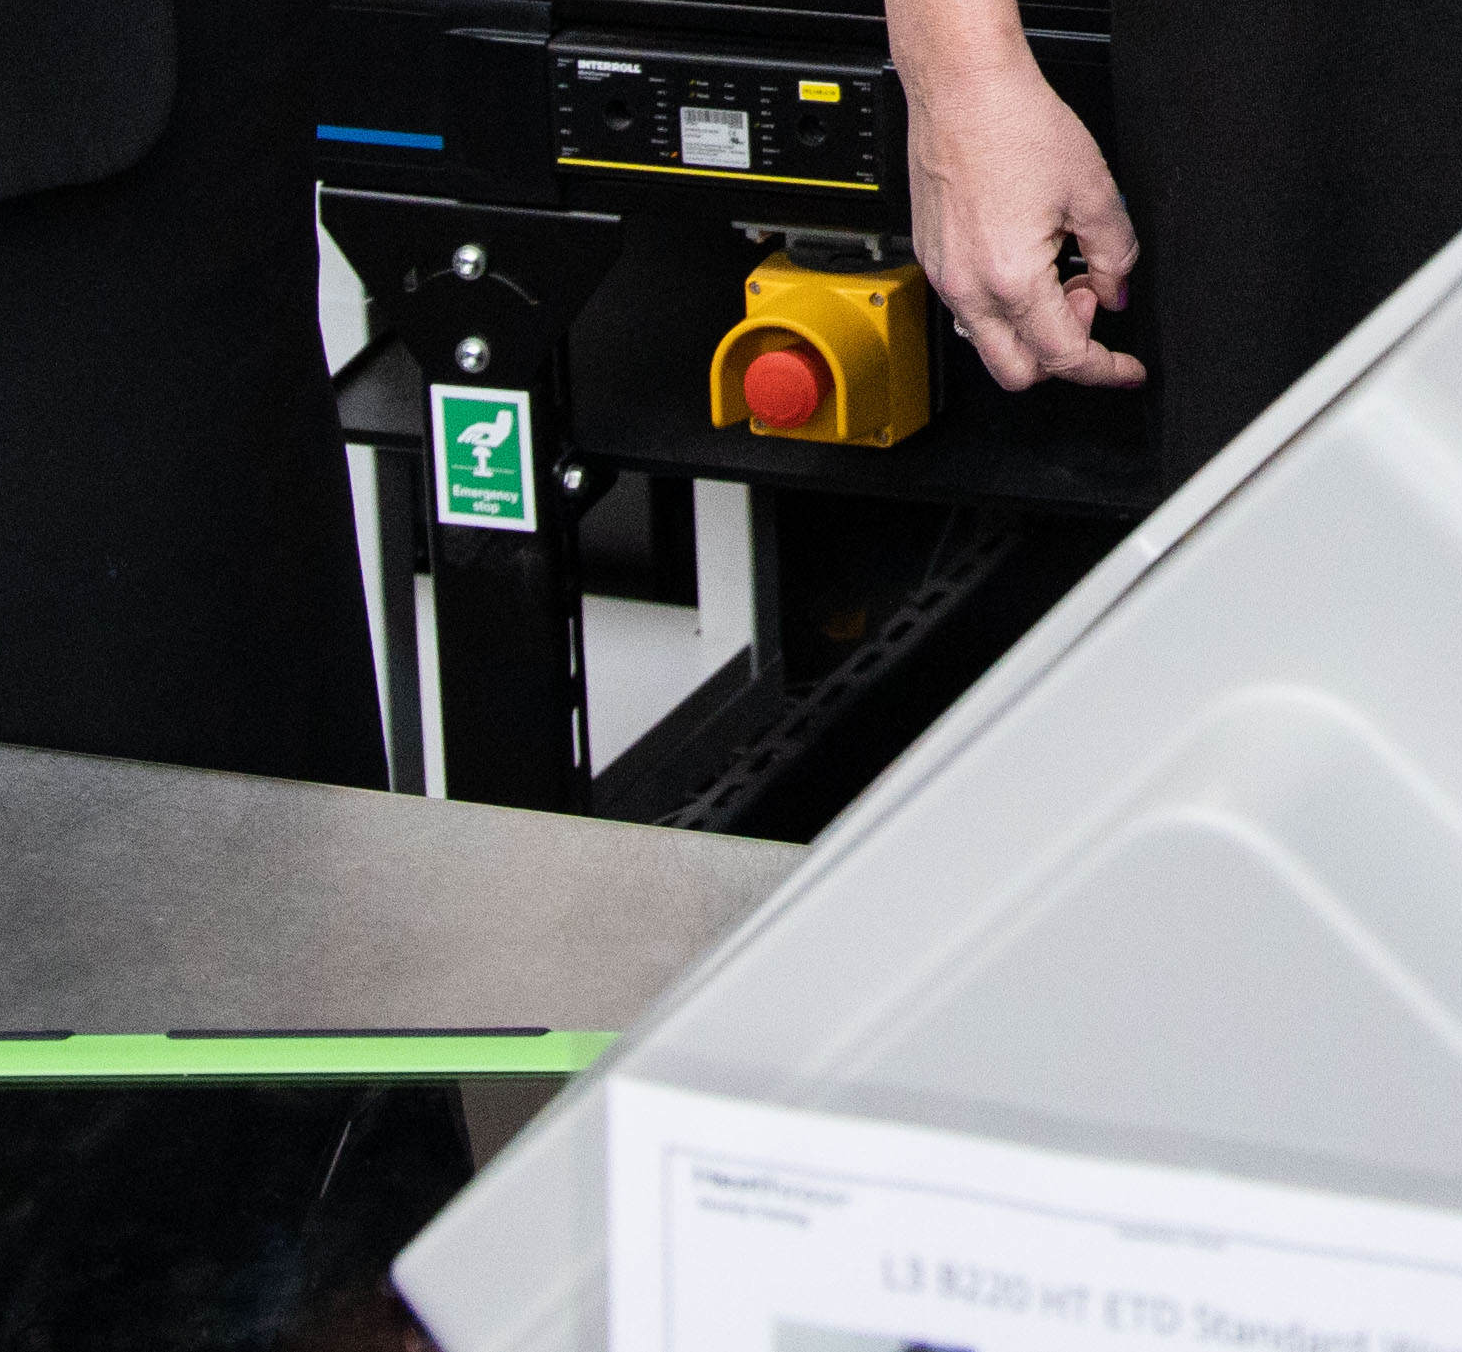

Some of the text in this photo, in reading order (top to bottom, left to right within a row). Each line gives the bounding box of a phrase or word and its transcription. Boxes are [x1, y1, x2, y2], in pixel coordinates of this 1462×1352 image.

[577, 59, 643, 75] INTERROLL
[452, 483, 518, 505] Emergency
[472, 500, 500, 515] stop
[1036, 1274, 1091, 1323] HT
[1101, 1281, 1182, 1336] ETD
